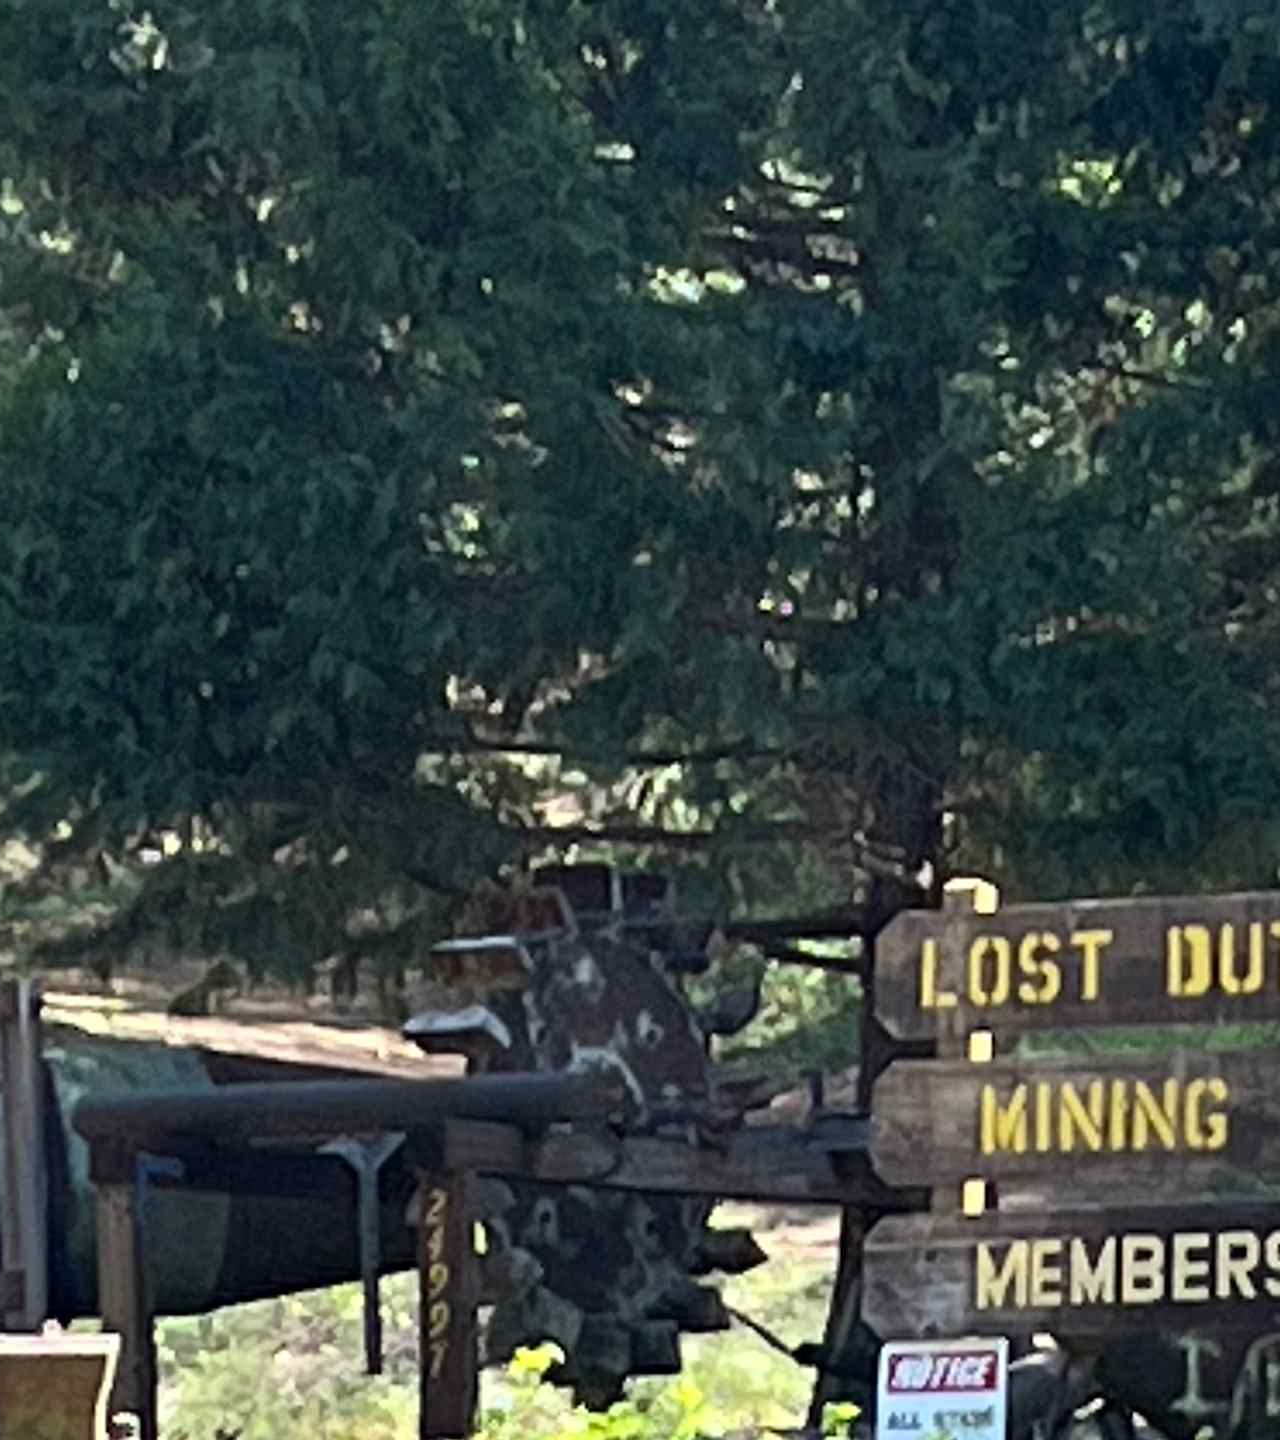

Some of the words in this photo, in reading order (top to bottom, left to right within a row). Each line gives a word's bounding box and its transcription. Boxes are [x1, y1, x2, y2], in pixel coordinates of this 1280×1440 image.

[920, 929, 1114, 1010] LOST
[980, 1077, 1229, 1156] MINING
[891, 1355, 994, 1389] NOTICE
